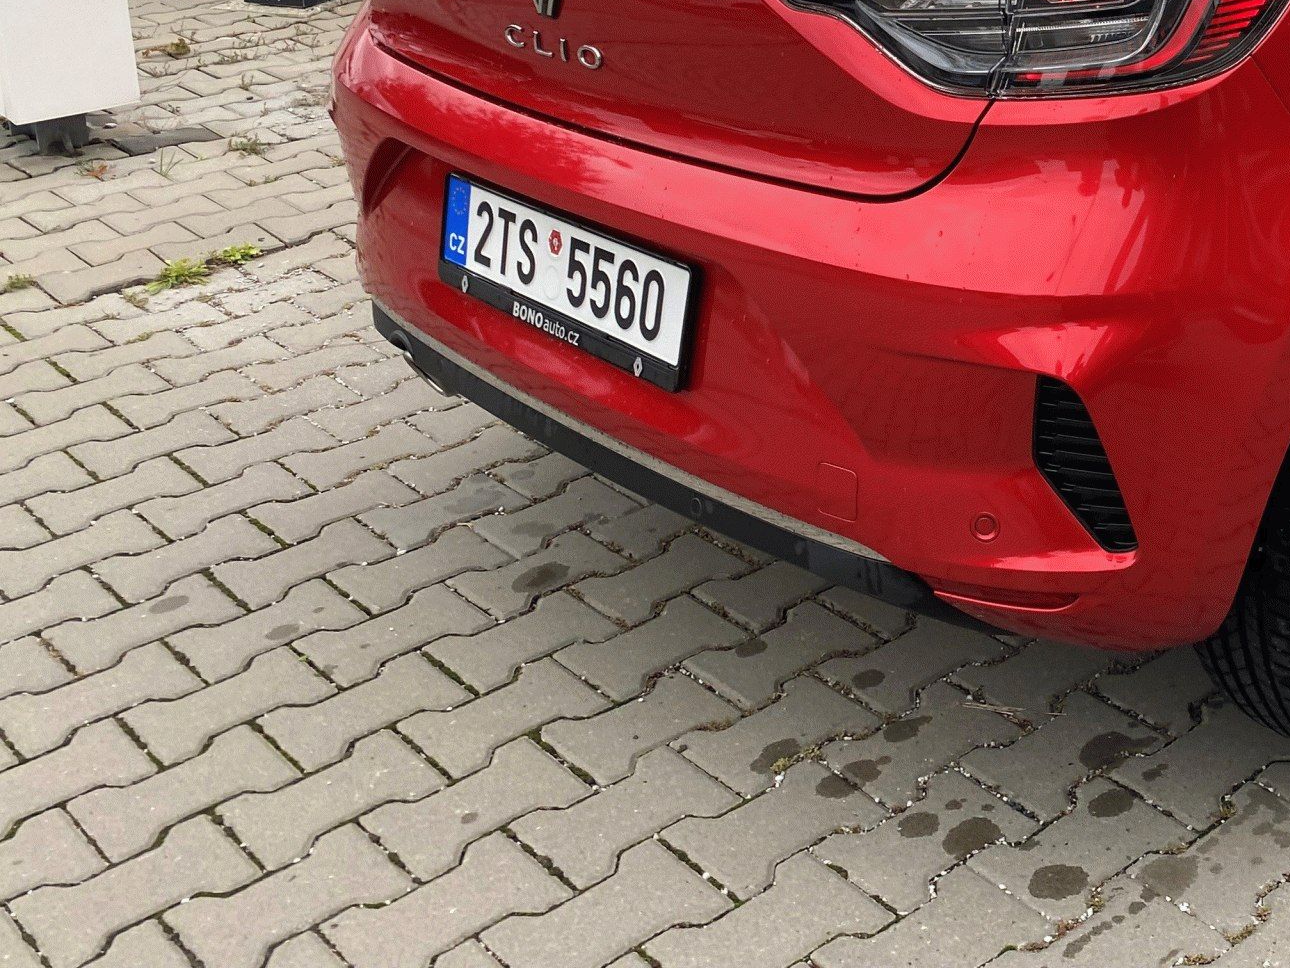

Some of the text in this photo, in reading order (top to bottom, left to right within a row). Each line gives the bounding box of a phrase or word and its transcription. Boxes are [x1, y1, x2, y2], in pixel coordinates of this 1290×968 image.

[504, 24, 604, 70] CLIO
[449, 232, 465, 255] CZ
[474, 200, 665, 341] 2TS 5560
[512, 301, 580, 346] BONOauto.cz
